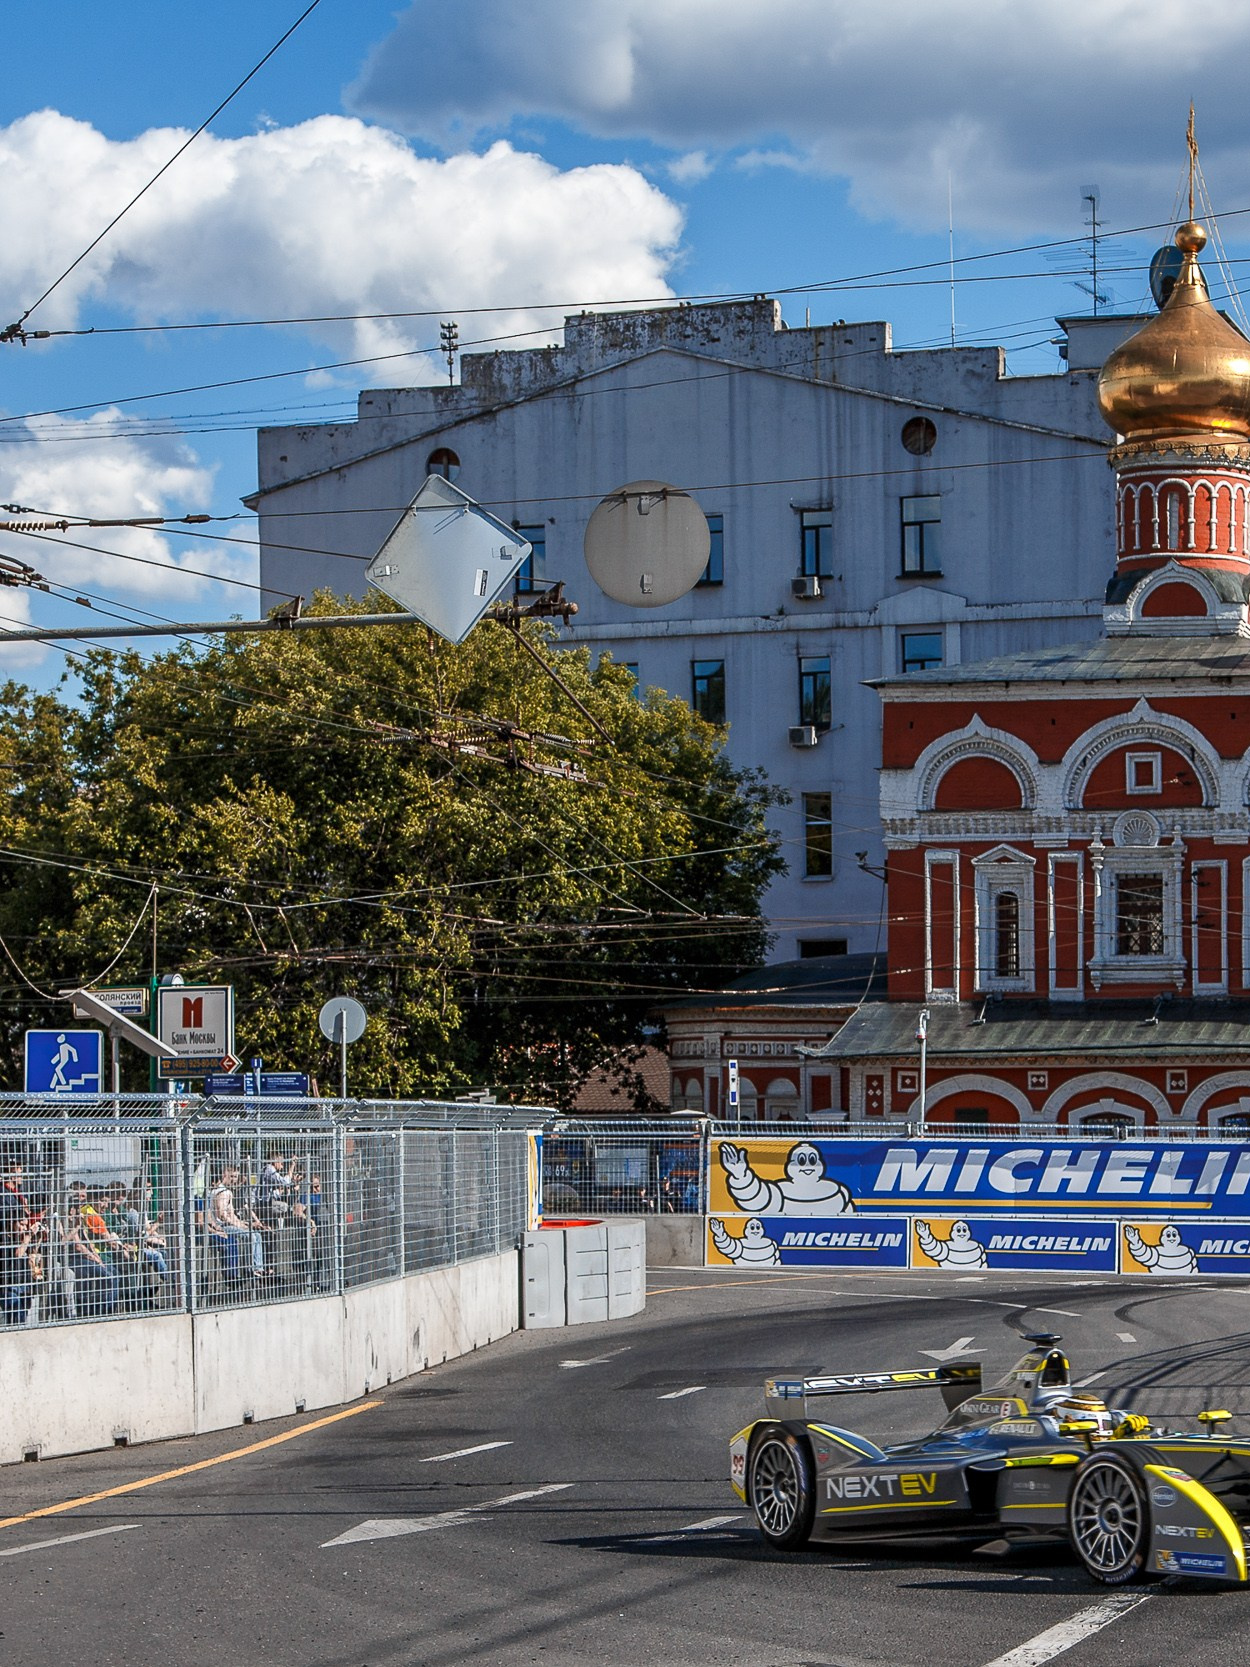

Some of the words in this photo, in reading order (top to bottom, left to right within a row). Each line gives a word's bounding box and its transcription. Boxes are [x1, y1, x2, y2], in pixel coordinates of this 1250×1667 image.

[171, 1032, 188, 1045] Банк
[189, 1031, 216, 1045] Москвы
[781, 1232, 903, 1247] MICHELIN
[989, 1235, 1112, 1251] MICHELIN
[826, 1472, 937, 1499] NEXTEV
[1155, 1524, 1215, 1539] NEXTEV
